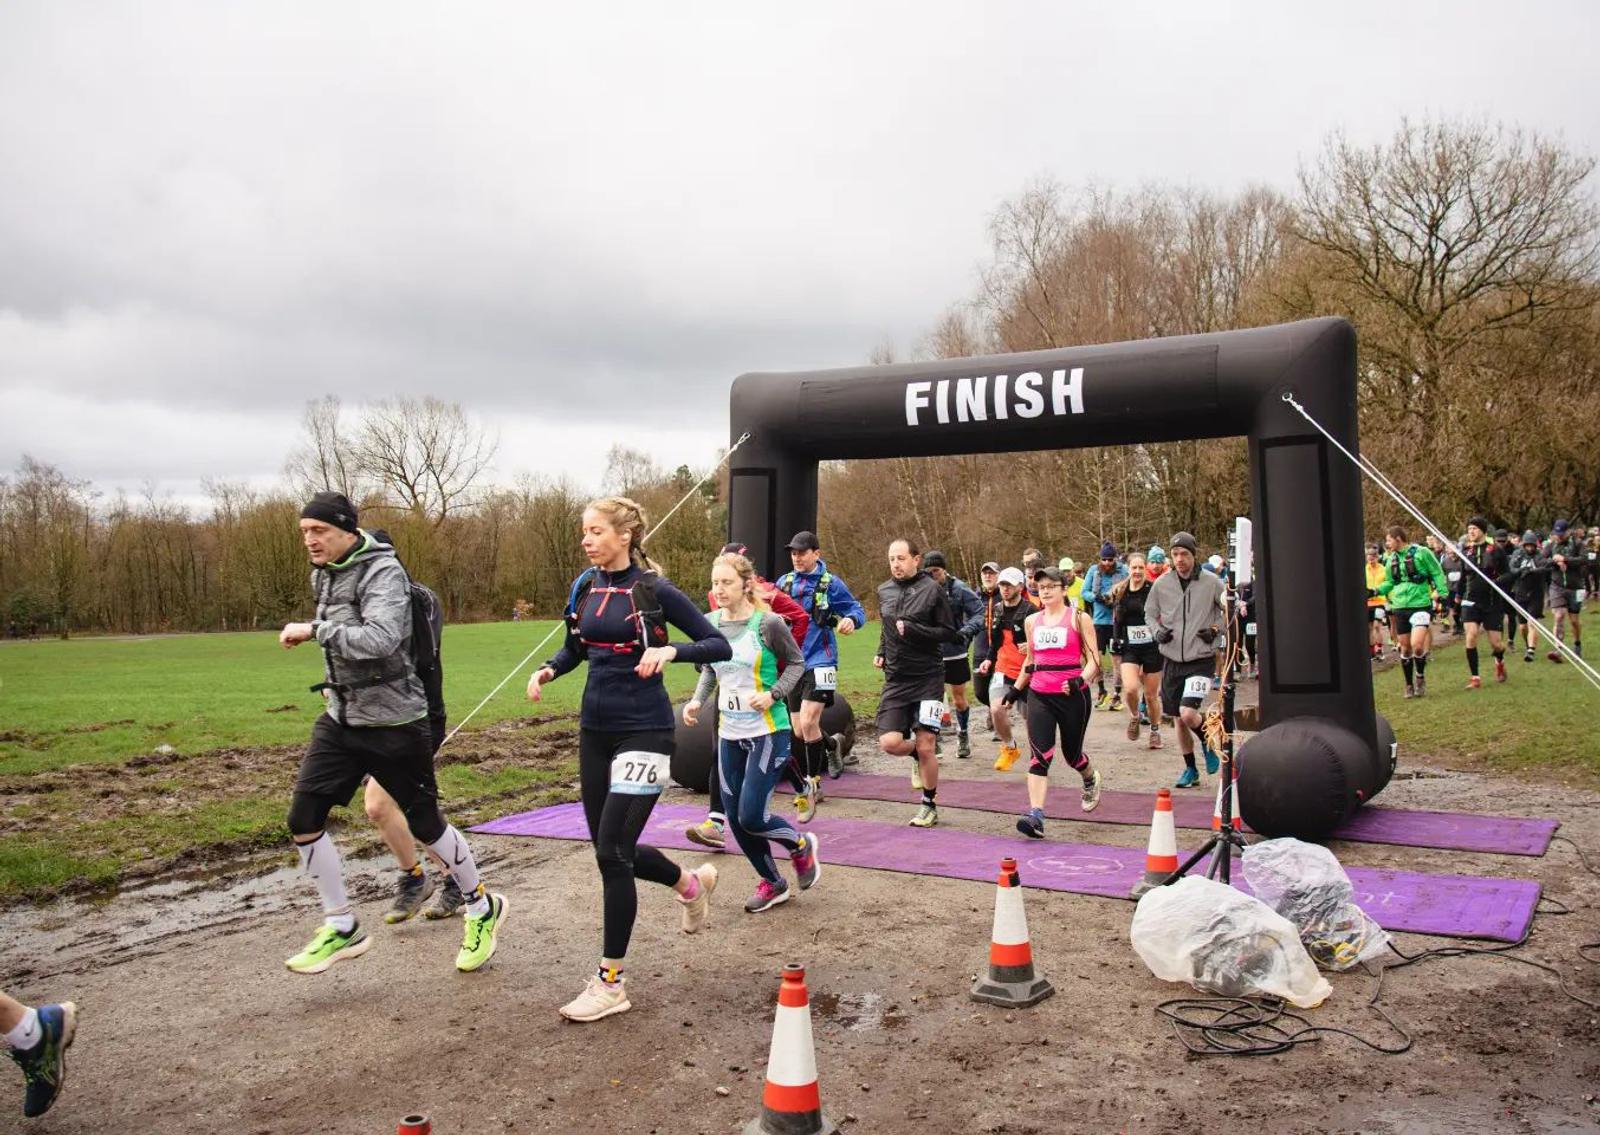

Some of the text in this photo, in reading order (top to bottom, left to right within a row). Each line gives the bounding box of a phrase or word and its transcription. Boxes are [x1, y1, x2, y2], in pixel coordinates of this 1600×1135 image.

[905, 368, 1085, 427] FINISH
[1038, 631, 1059, 644] 306
[1131, 630, 1147, 640] 205
[1190, 681, 1207, 692] 134
[728, 695, 741, 711] 61
[624, 761, 658, 784] 276
